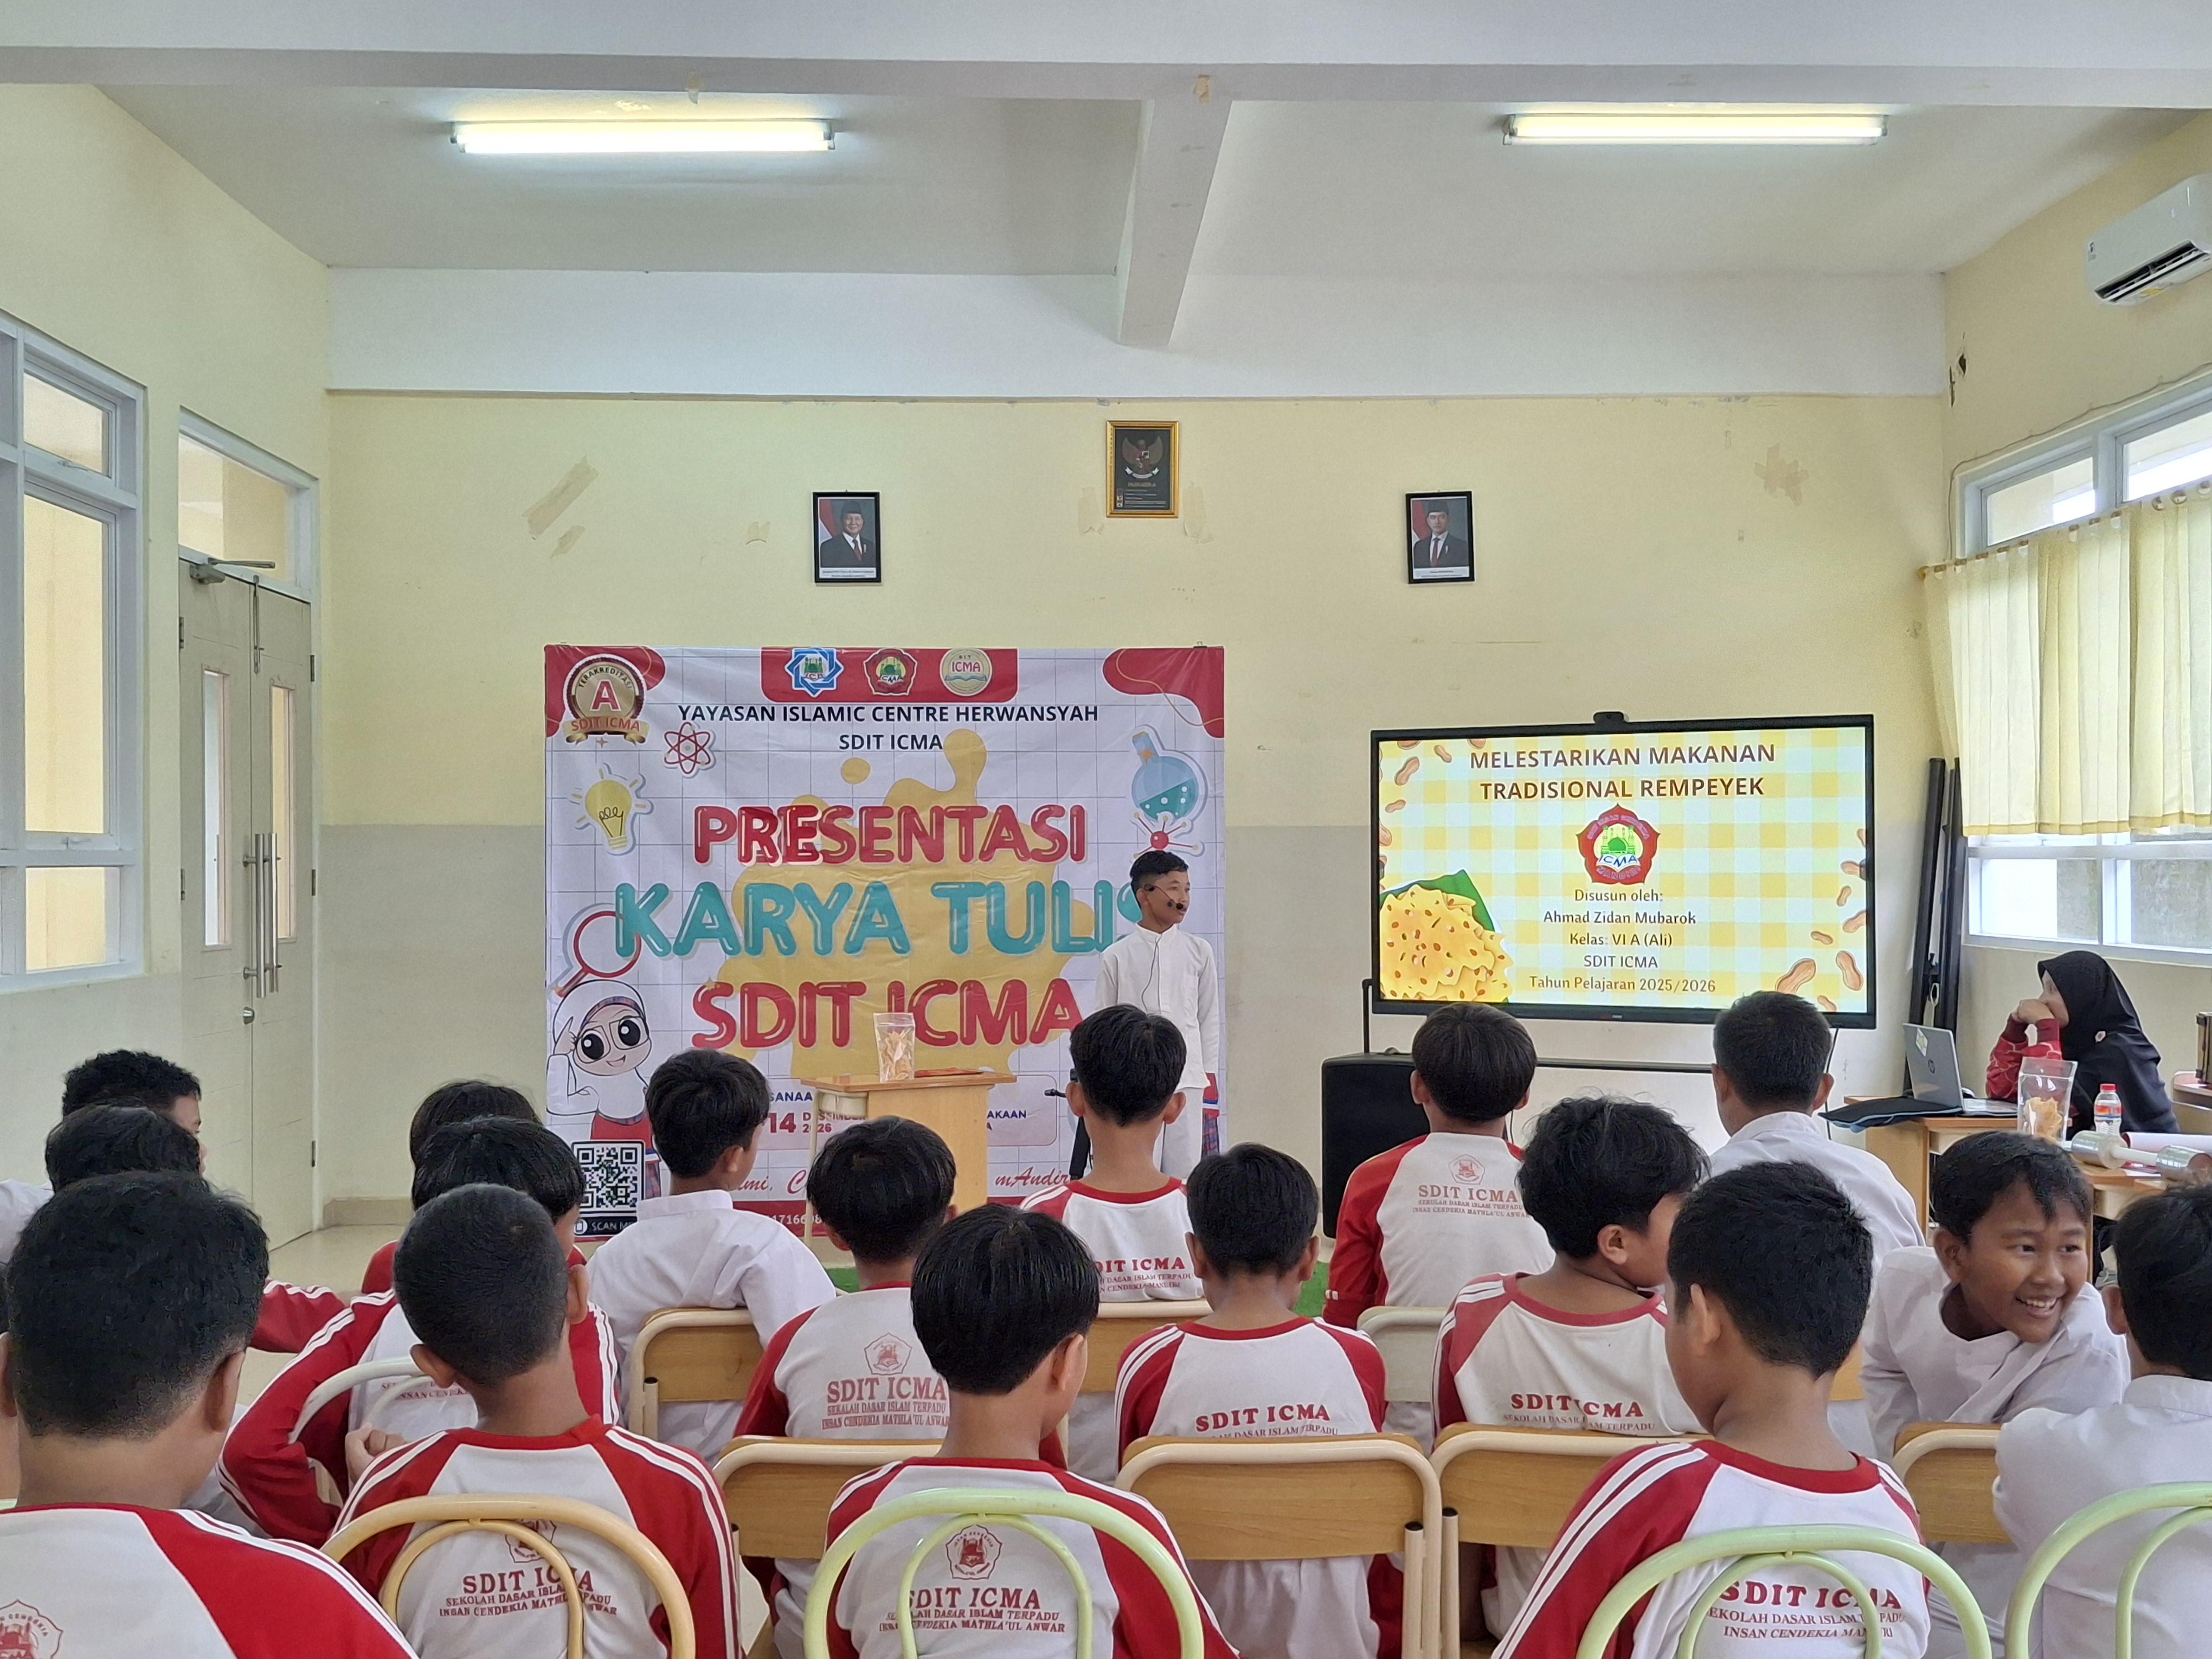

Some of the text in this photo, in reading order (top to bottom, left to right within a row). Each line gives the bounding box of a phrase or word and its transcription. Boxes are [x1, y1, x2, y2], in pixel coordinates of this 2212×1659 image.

[951, 661, 981, 672] ICMA
[590, 680, 621, 711] A
[678, 705, 1098, 722] YAYASAN ISLAMIC CENTRE HERWANSYAH
[571, 717, 641, 731] SDIT ICMA
[839, 734, 943, 750] SDIT ICMA
[1470, 744, 1774, 769] MELESTARIKAN MAKANAN
[1480, 777, 1764, 800] TRADISIONAL REMPEYEK
[694, 805, 1086, 864] PRESENTASI
[1598, 855, 1637, 867] ICMA
[1574, 889, 1663, 902] Disusun oleh:
[615, 882, 911, 956] KARYA
[1544, 911, 1696, 924] Ahmad Zidan Mubarok
[1570, 933, 1673, 948] Kelas: VI A (Ali)
[1584, 955, 1658, 968] SDIT ICMA
[1529, 976, 1715, 993] Tahun Pelajaran 2025/2026
[692, 978, 1084, 1049] SDIT ICMA
[768, 1113, 796, 1133] 14
[1418, 1185, 1518, 1203] SDIT ICMA
[591, 1221, 618, 1231] SCAN
[1096, 1257, 1186, 1273] DIT ICMA
[827, 1377, 947, 1403] SDIT ICMA
[912, 1401, 947, 1414] TERPADU
[1510, 1393, 1572, 1411] SDIT
[1195, 1404, 1330, 1432] SDIT ICMA
[1268, 1426, 1298, 1436] ISLAM
[462, 1565, 594, 1594] SDIT ICA
[446, 1596, 496, 1607] SEKOLAH
[498, 1590, 536, 1604] DASAR
[968, 1587, 1041, 1610] ICMA
[1719, 1580, 1808, 1607] SDIT
[1007, 1610, 1060, 1621] TERPADU
[1708, 1606, 1768, 1624] EKOLAH
[1772, 1613, 1816, 1624] DASAR
[1819, 1614, 1857, 1624] ISLAM
[1026, 1622, 1066, 1633] ANWAR
[1724, 1625, 1767, 1638] INSAN
[1771, 1628, 1837, 1638] CENDEKIA
